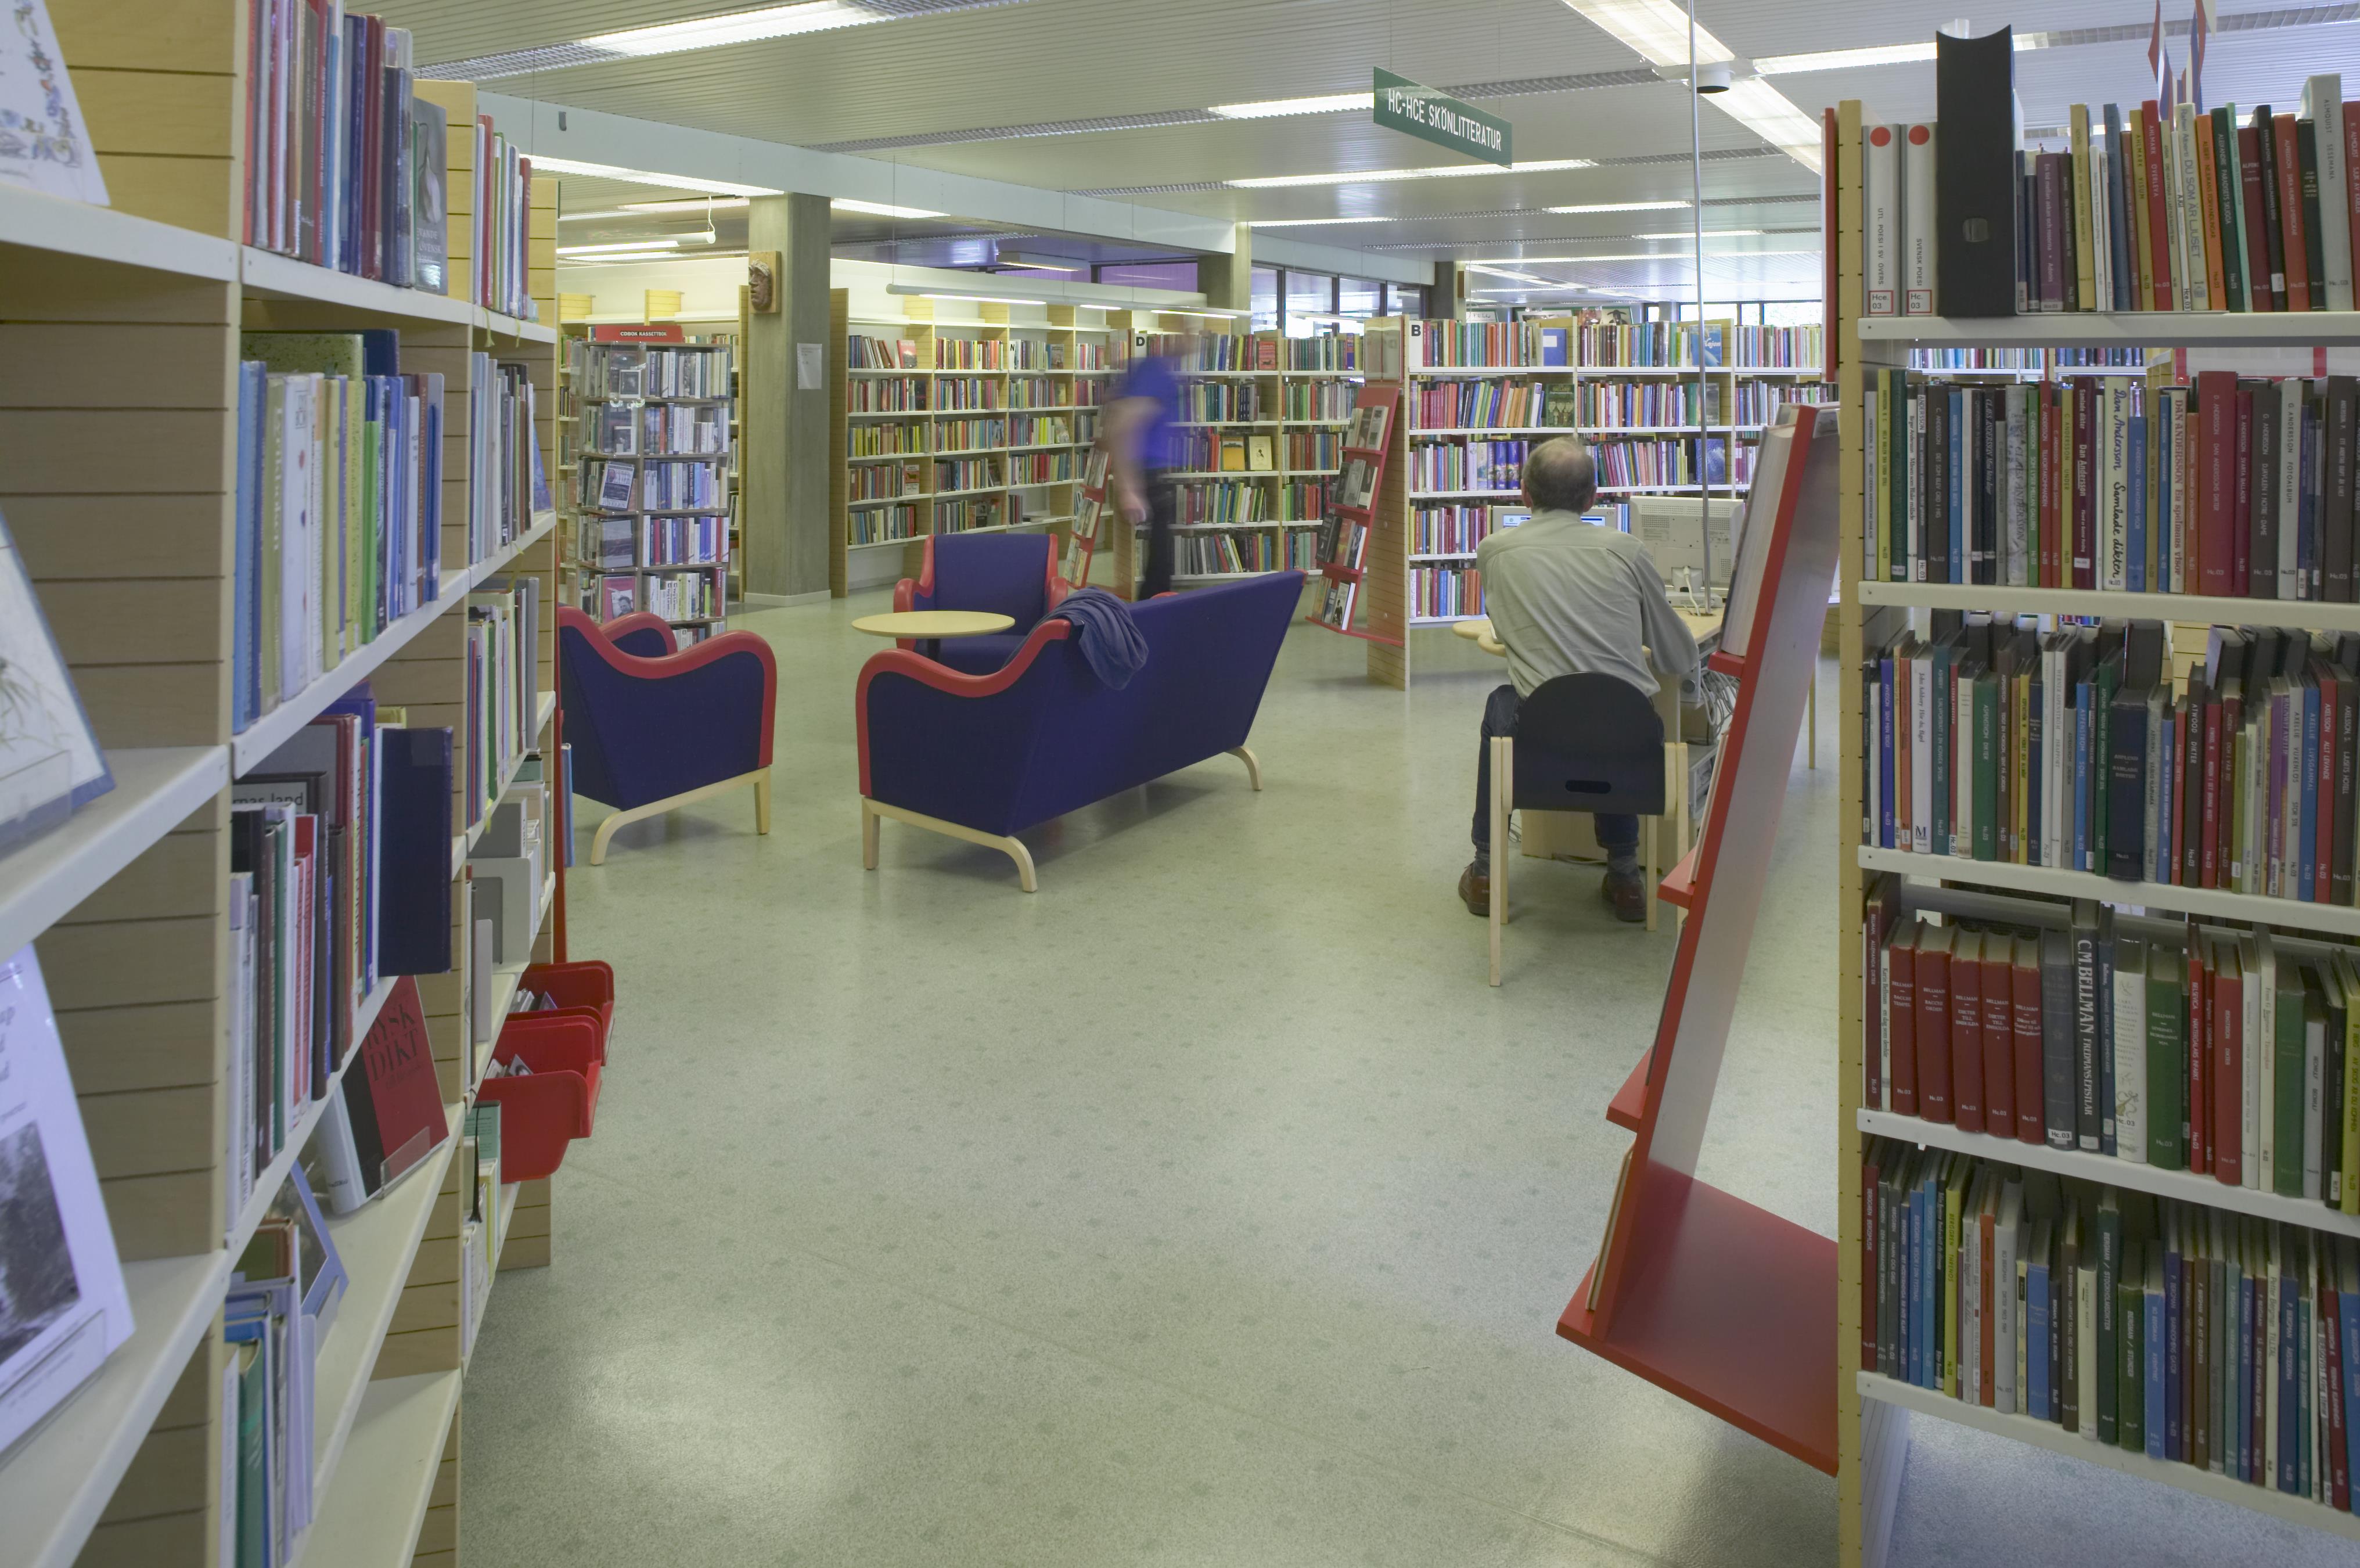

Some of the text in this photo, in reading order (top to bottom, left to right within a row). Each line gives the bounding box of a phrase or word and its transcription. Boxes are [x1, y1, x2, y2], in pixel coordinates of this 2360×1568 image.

[1388, 88, 1502, 151] HC-HCE SKÖNLITTERATUR
[2323, 99, 2335, 180] ALMQUIST SESEMANA
[2180, 109, 2201, 258] Rafael Alberti DU SOM ÄR LJUSET
[2221, 170, 2229, 200] PARADISETS
[1136, 336, 1145, 346] D
[1411, 325, 1421, 336] B
[2015, 446, 2025, 542] CLAES ANDERSSON
[2078, 460, 2086, 497] Andersson
[2113, 389, 2127, 578] Dan Andersson Samlade dikter
[2172, 400, 2183, 576] DAN ANDERSSON En spelmans visor
[1917, 685, 1926, 707] Ashbery
[1915, 826, 1926, 836] M
[2077, 940, 2094, 1034] C.M.BELLMAN
[1880, 1017, 1888, 1027] dag
[369, 1028, 419, 1081] DIKT
[2050, 1131, 2070, 1139] Hc.03
[2116, 1117, 2135, 1127] Hc.03
[2268, 1299, 2276, 1327] Bergman
